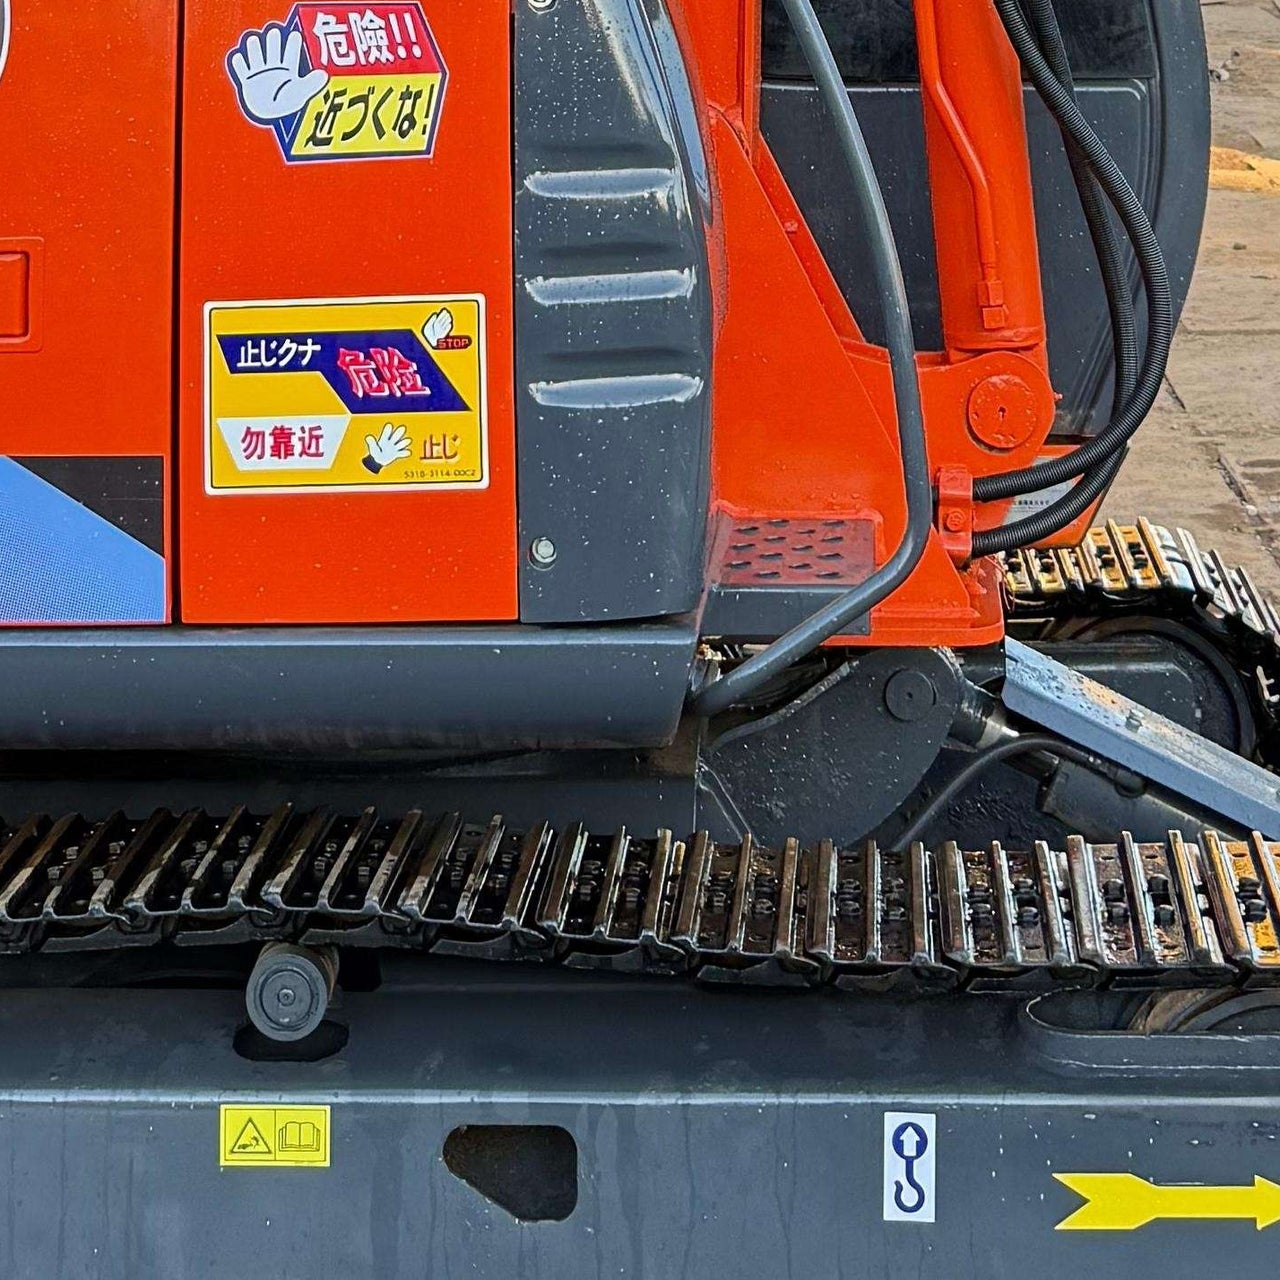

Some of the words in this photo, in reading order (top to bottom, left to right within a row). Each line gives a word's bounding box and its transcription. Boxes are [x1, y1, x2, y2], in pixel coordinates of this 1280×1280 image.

[437, 338, 470, 349] STOP
[240, 423, 326, 462] 勿靠近
